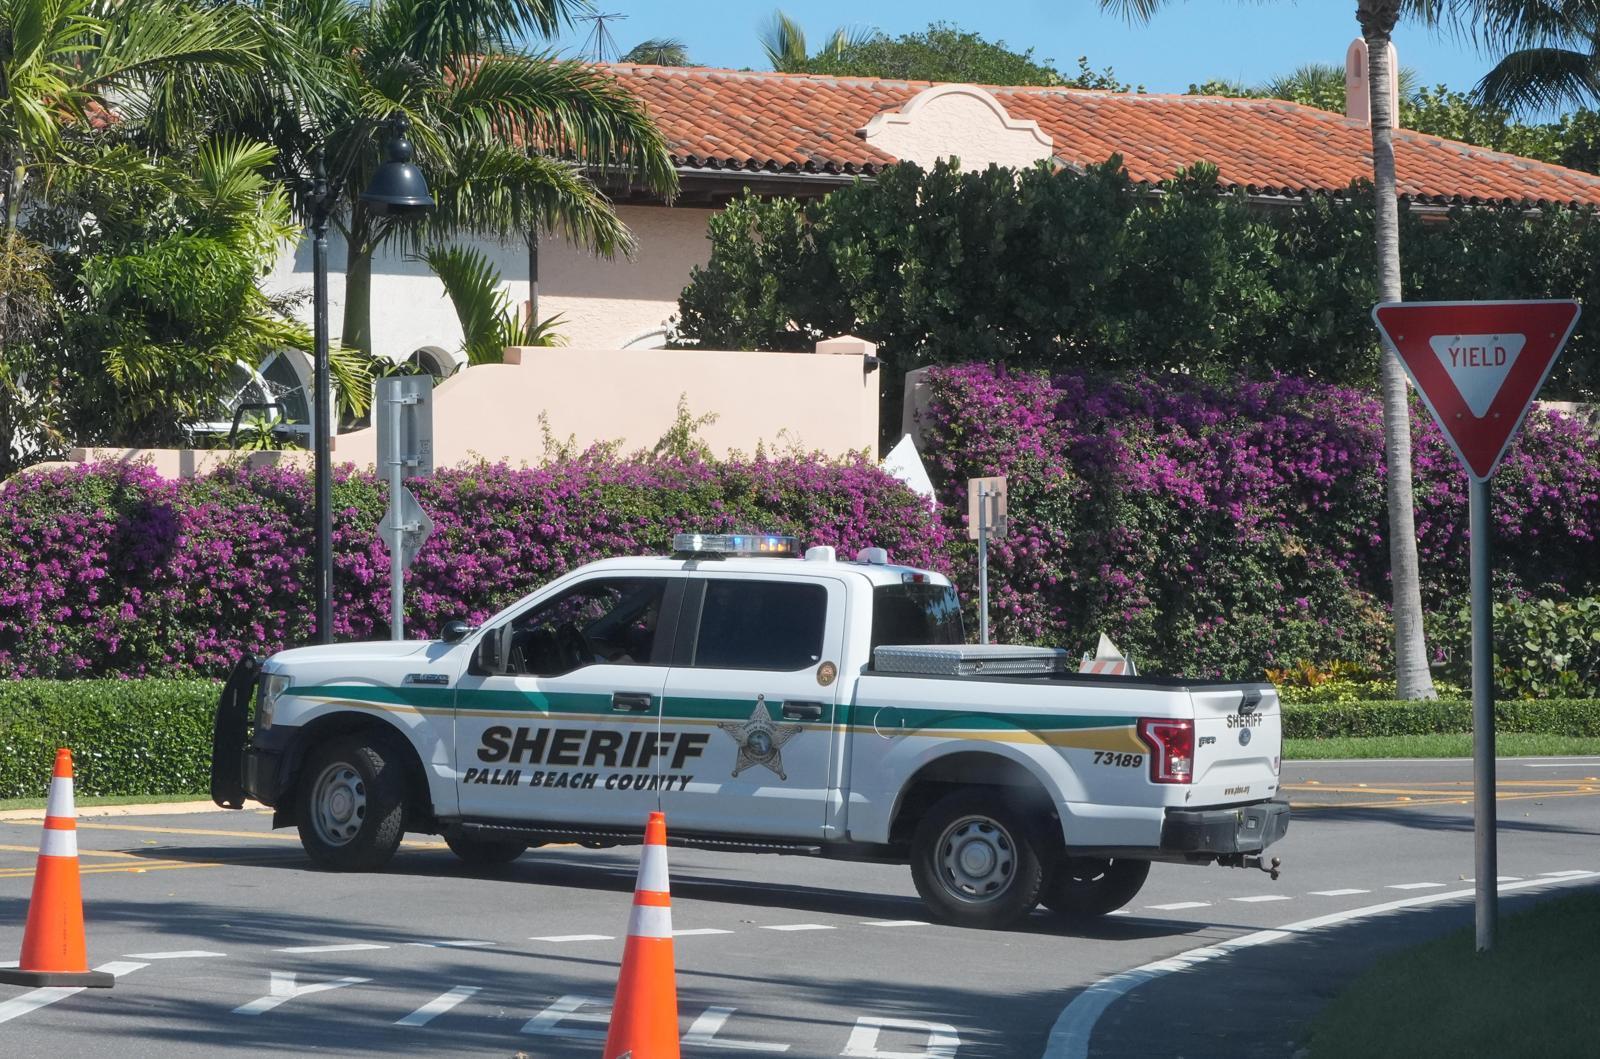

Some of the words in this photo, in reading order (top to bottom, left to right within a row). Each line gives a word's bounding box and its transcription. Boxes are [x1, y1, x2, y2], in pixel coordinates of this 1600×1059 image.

[1448, 347, 1506, 367] YIELD
[1226, 712, 1262, 728] SHERIFF
[477, 725, 711, 769] SHERIFF
[1093, 751, 1143, 768] 73189
[463, 768, 521, 786] PALM
[529, 771, 599, 789] BEACH
[605, 773, 694, 791] COUNTY
